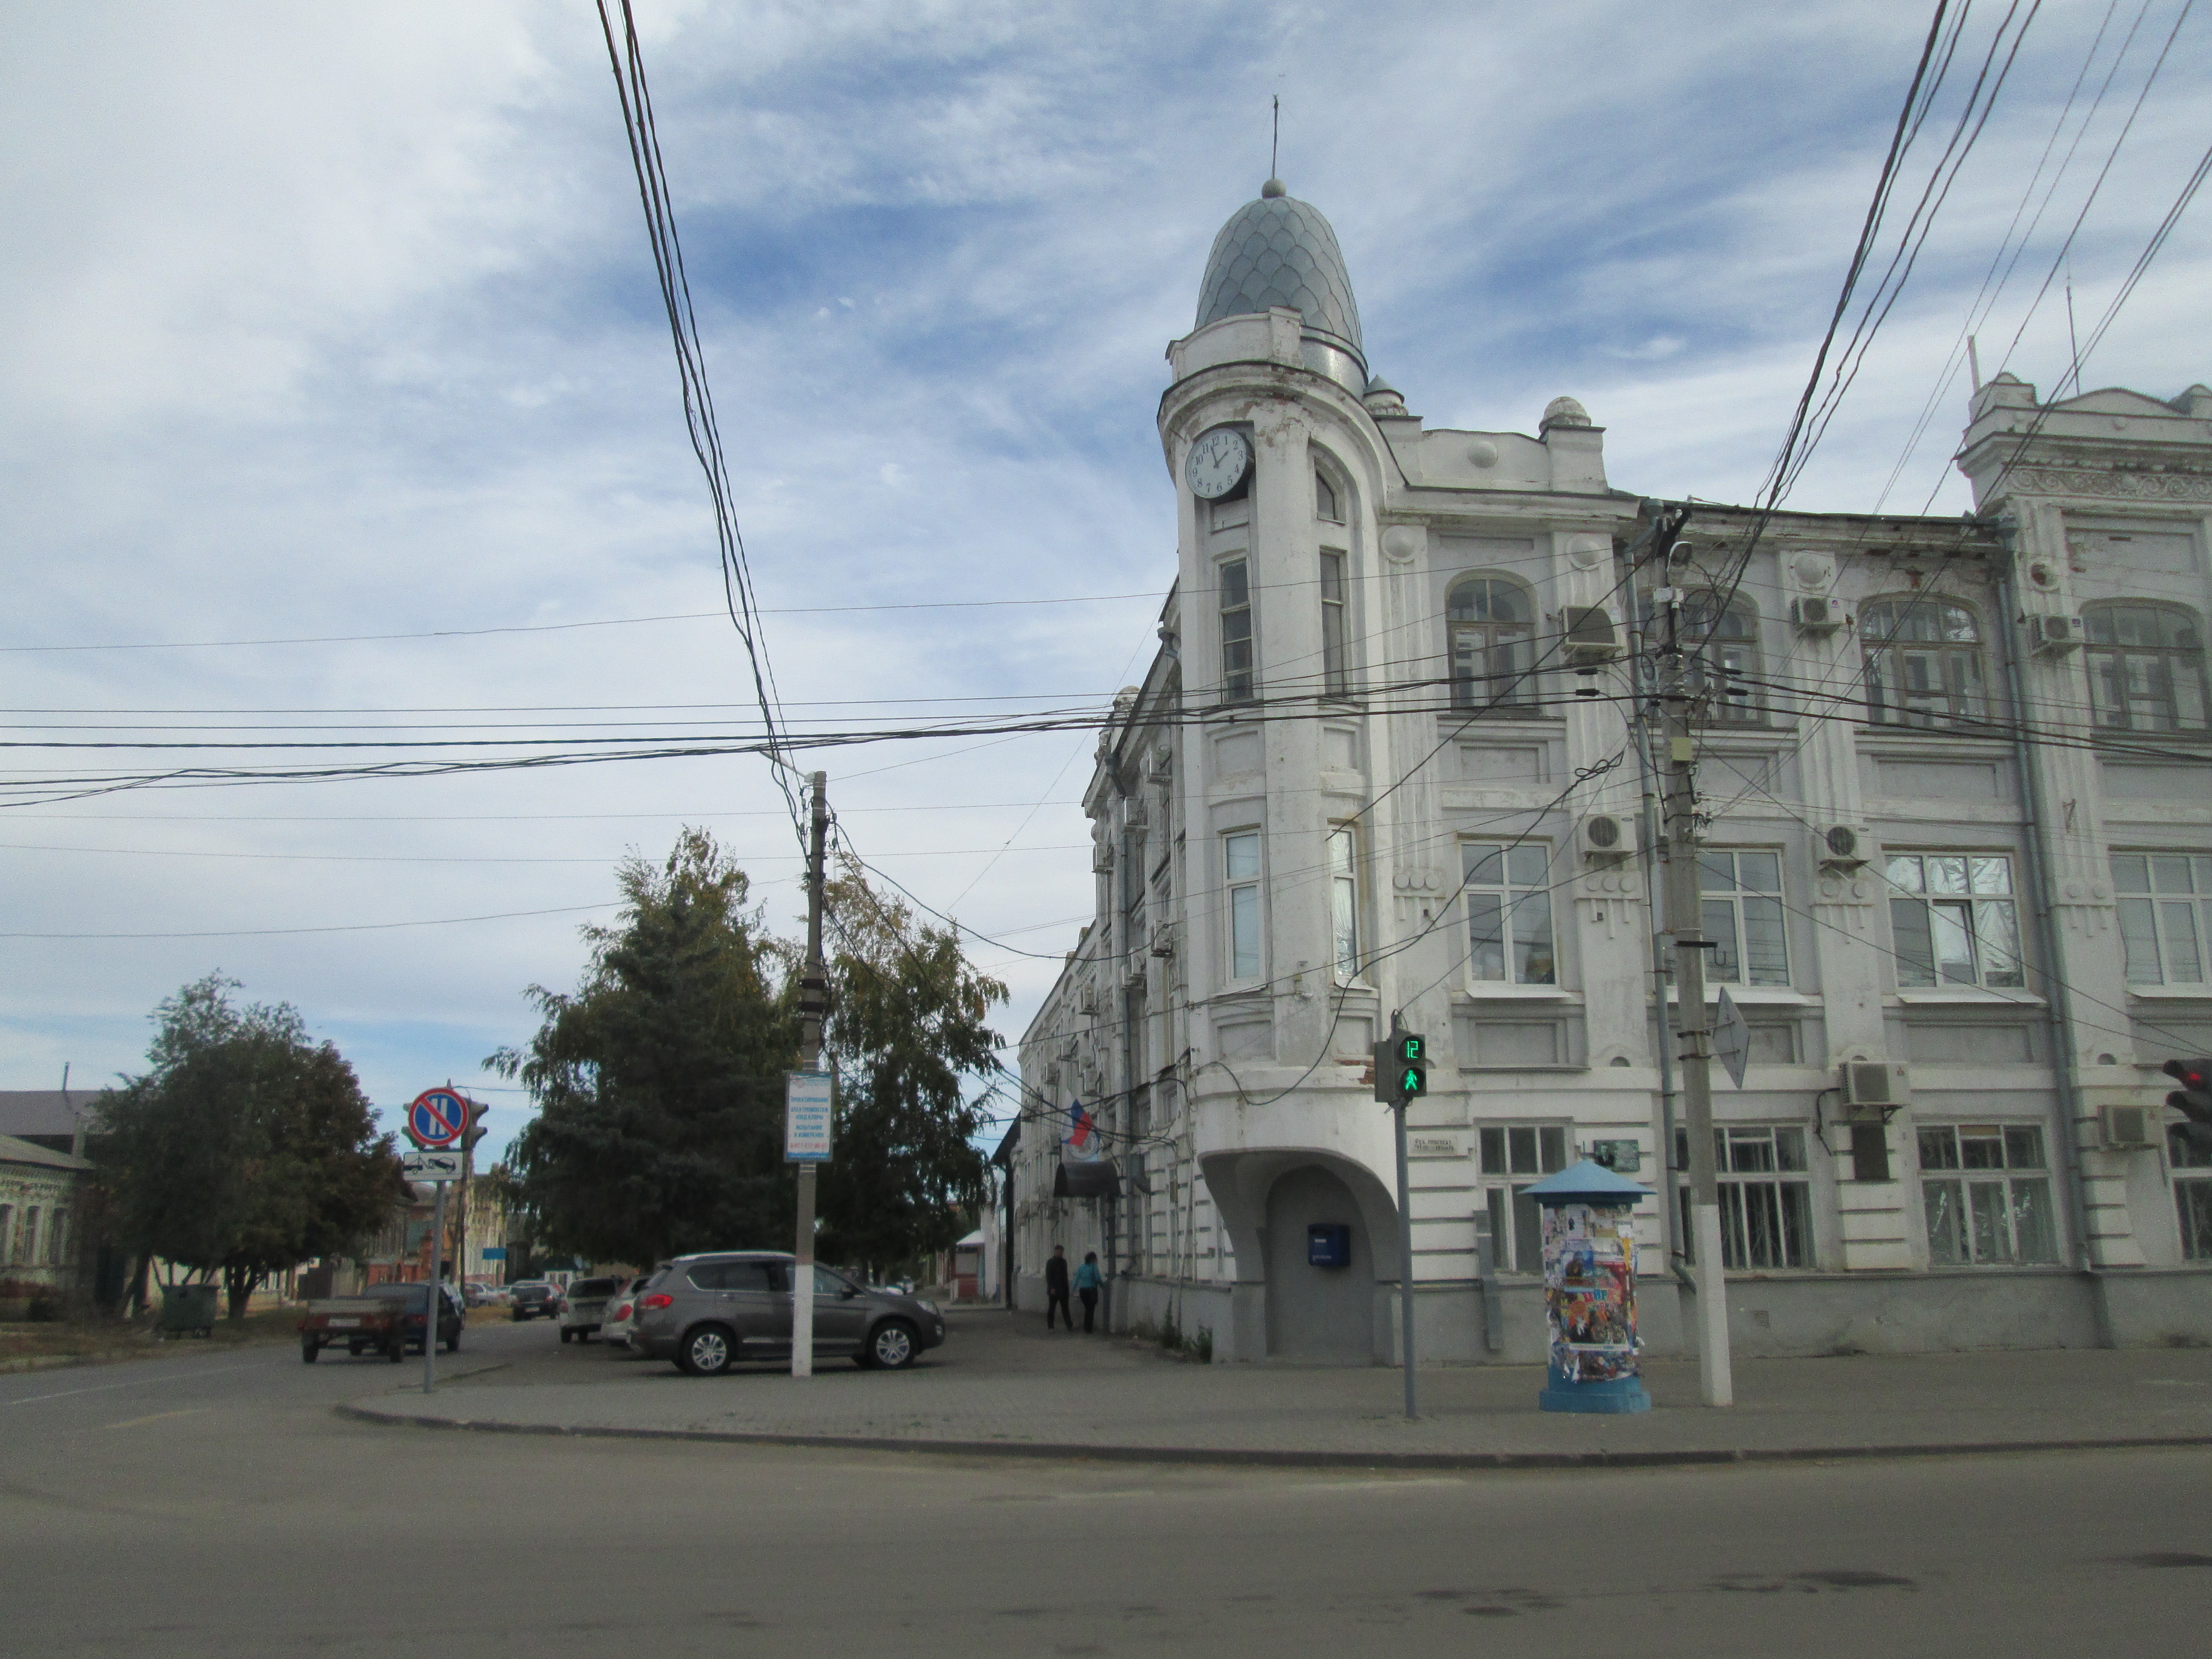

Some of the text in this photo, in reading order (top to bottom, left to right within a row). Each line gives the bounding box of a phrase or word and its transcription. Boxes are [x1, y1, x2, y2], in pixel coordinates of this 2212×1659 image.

[1212, 436, 1220, 446] 12
[1224, 436, 1228, 445] 1
[1233, 440, 1238, 450] 2
[1202, 444, 1209, 454] 11
[1195, 454, 1203, 465] 10
[1238, 450, 1243, 460] 3
[1192, 468, 1198, 477] 9
[1234, 464, 1238, 473] 4
[1197, 478, 1202, 487] 8
[1227, 475, 1232, 485] 5
[1206, 483, 1211, 493] 7
[1217, 482, 1222, 492] 6
[1407, 1041, 1418, 1058] 12
